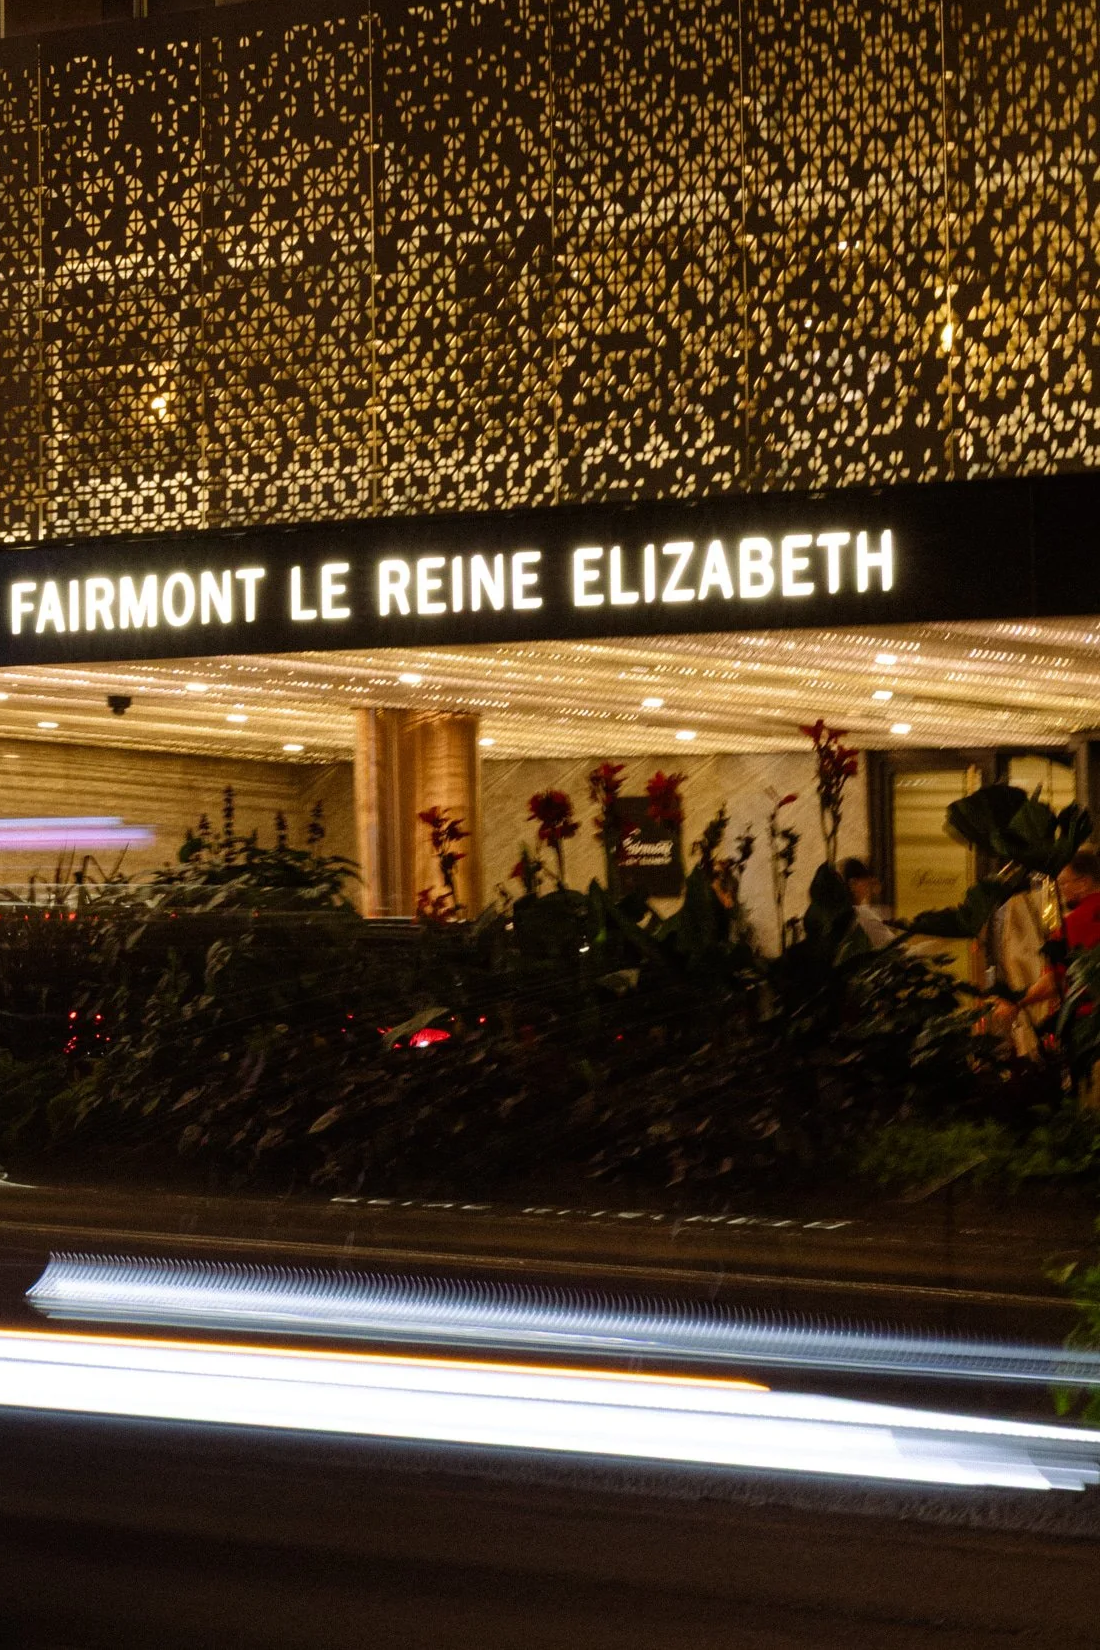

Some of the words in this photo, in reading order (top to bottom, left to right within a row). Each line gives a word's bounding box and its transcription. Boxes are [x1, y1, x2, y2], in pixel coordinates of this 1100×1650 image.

[10, 567, 266, 635] FAIRMONT
[290, 562, 351, 621] LE
[377, 550, 544, 617] REINE
[572, 529, 894, 607] ELIZABETH
